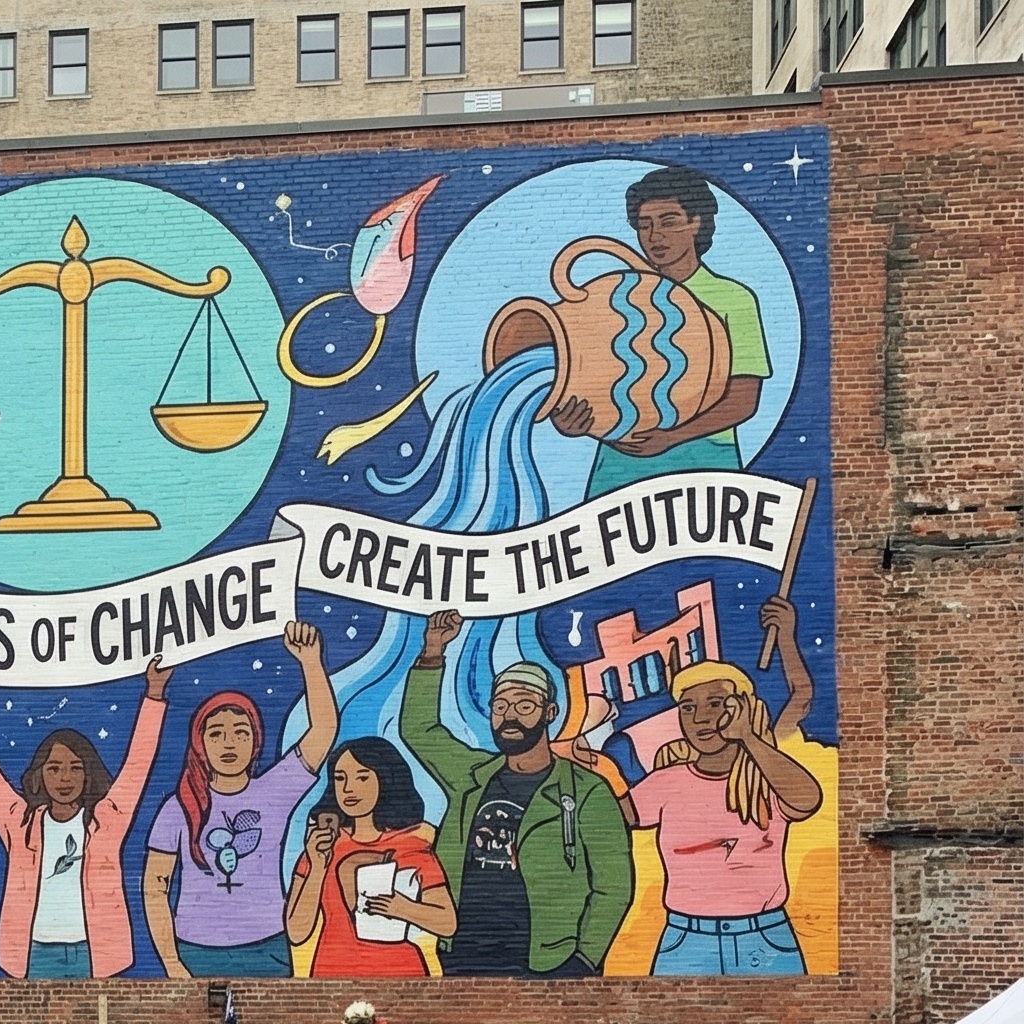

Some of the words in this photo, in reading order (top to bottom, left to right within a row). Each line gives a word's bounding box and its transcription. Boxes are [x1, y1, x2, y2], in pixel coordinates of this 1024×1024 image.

[318, 522, 490, 602] CREATE
[504, 524, 591, 594] THE
[596, 486, 782, 568] FUTURE
[31, 616, 77, 662] OF
[90, 559, 278, 666] CHANGE
